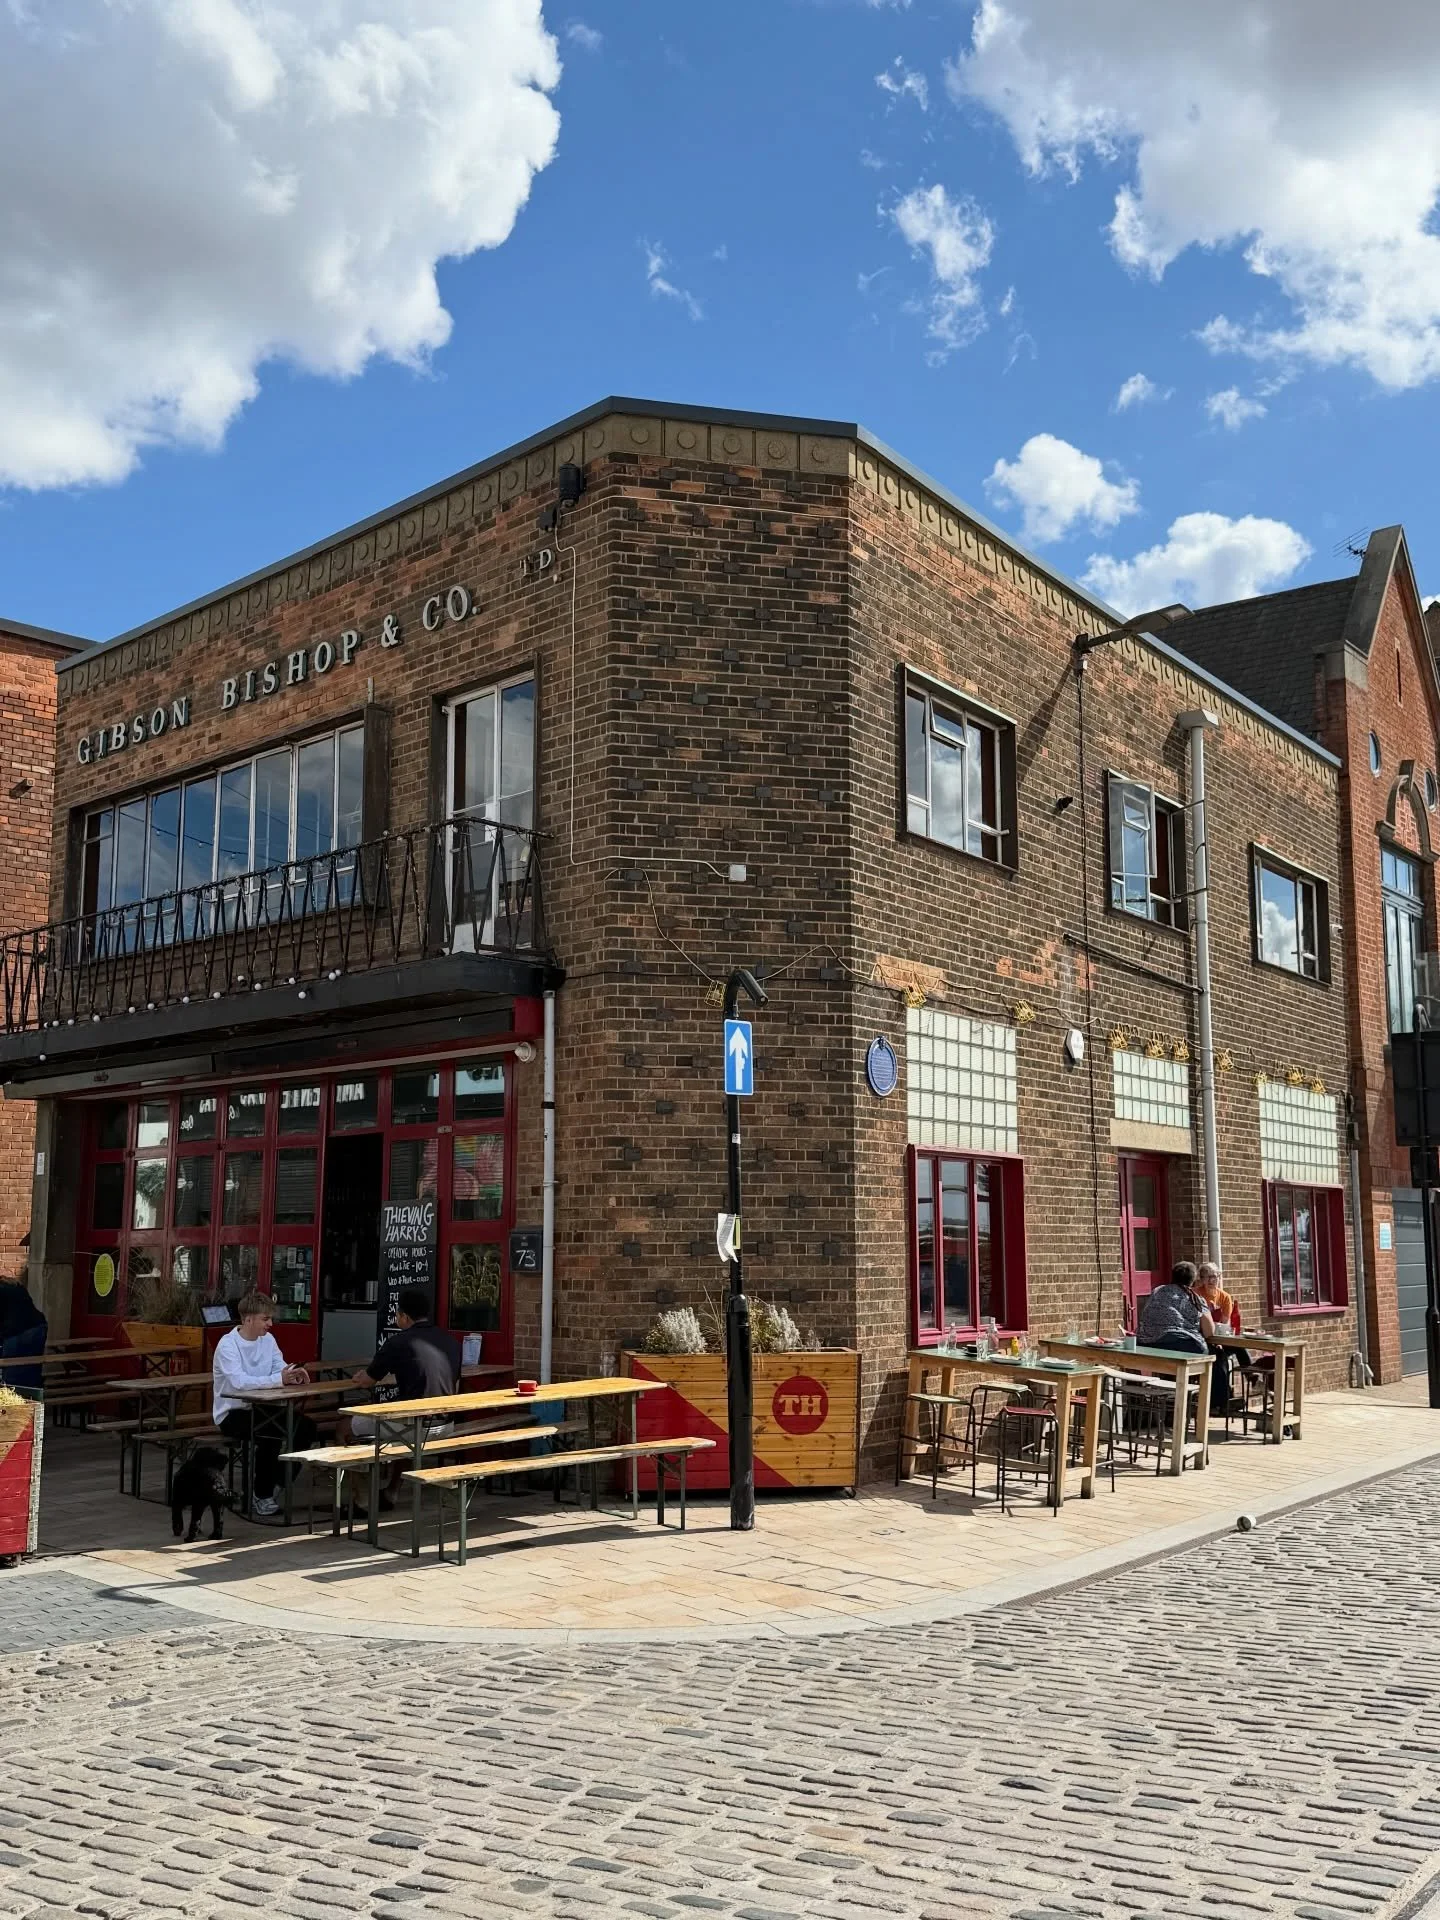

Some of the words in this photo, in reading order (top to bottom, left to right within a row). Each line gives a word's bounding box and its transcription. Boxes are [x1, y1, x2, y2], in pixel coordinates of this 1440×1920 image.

[77, 696, 191, 765] GIBSON
[221, 629, 363, 710] BISHOP
[381, 614, 400, 648] &
[422, 584, 481, 632] CO.
[384, 1202, 435, 1229] THIEVING
[385, 1224, 428, 1242] HARRY'S
[515, 1249, 536, 1267] 73
[389, 1292, 400, 1302] FRI
[778, 1394, 823, 1416] TH
